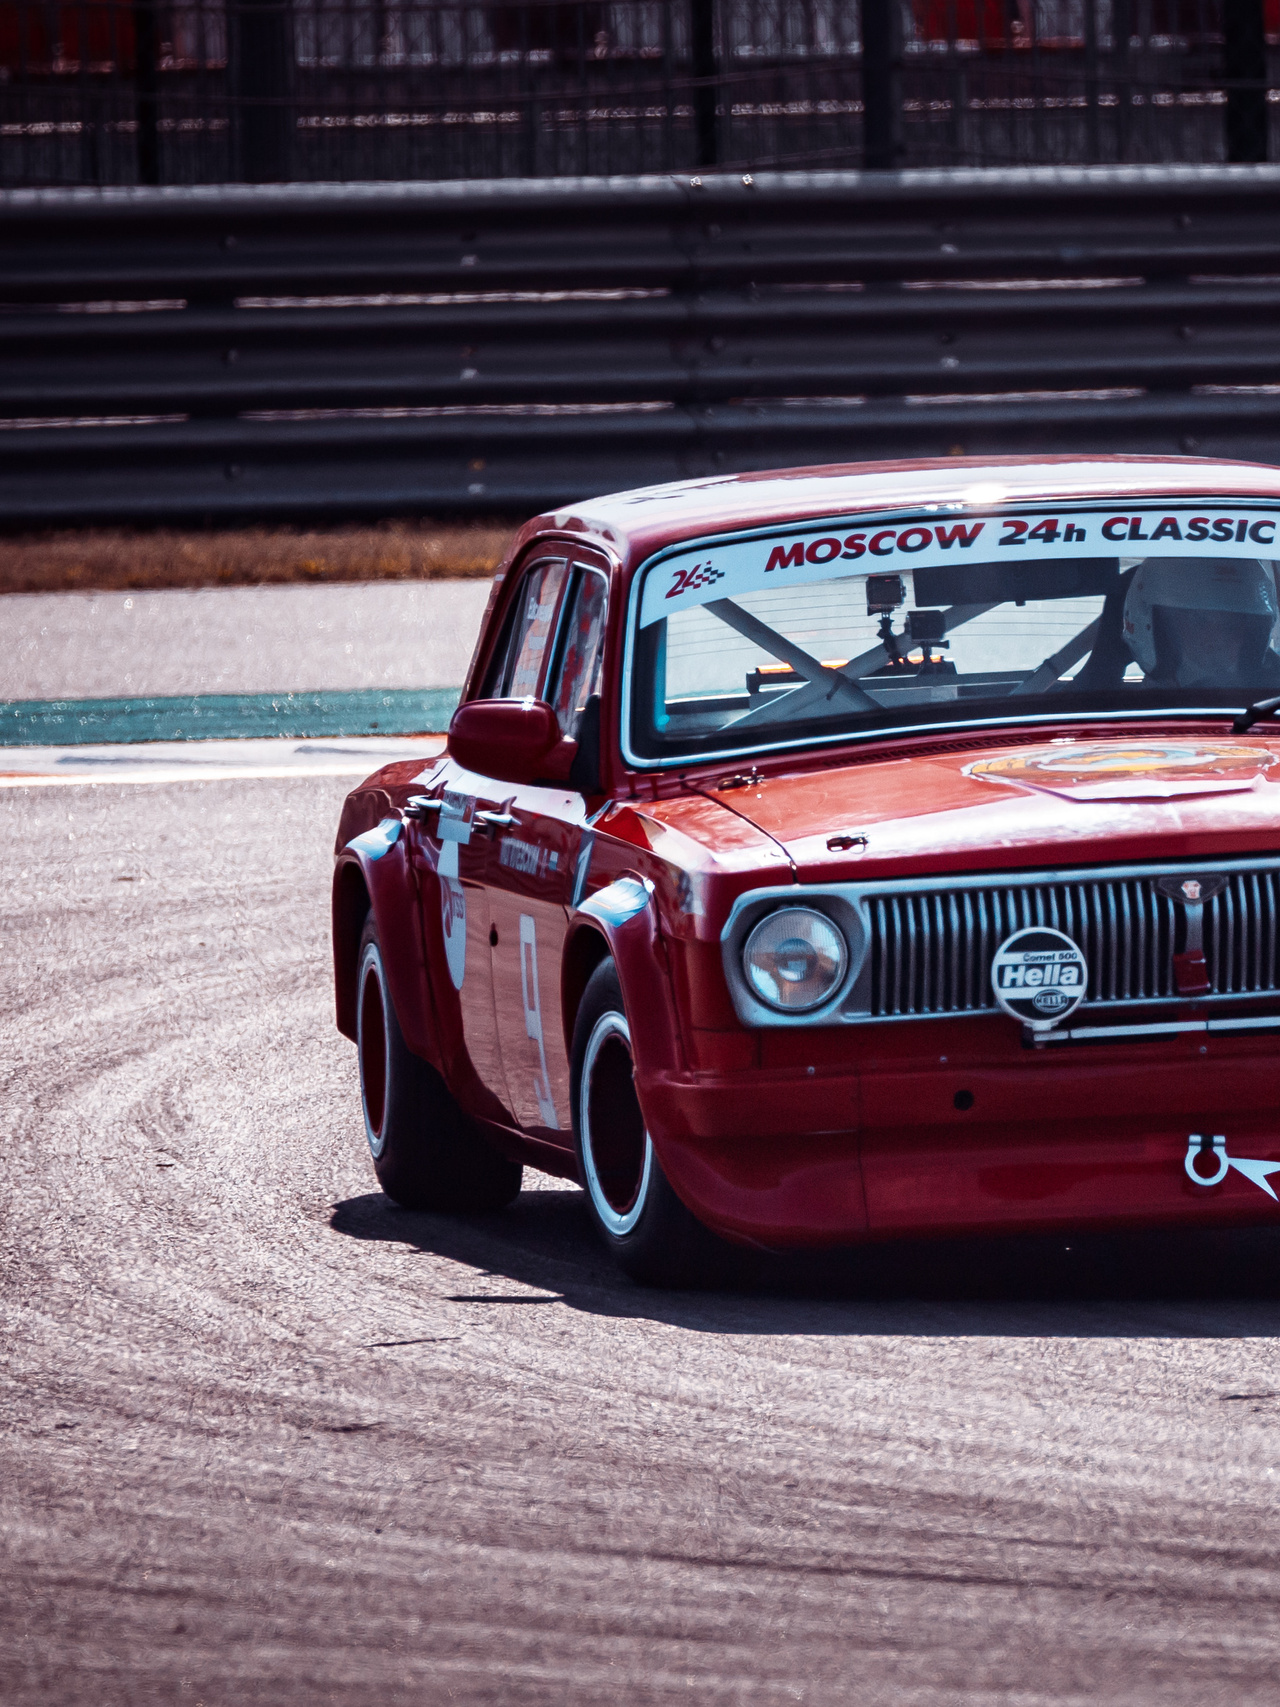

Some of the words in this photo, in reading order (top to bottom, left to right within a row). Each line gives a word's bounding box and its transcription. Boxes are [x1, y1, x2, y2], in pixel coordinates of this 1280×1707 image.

[764, 522, 986, 573] MOSCOW
[998, 518, 1087, 546] 24h
[1101, 516, 1277, 545] CLASSIC
[1002, 963, 1079, 988] Hella
